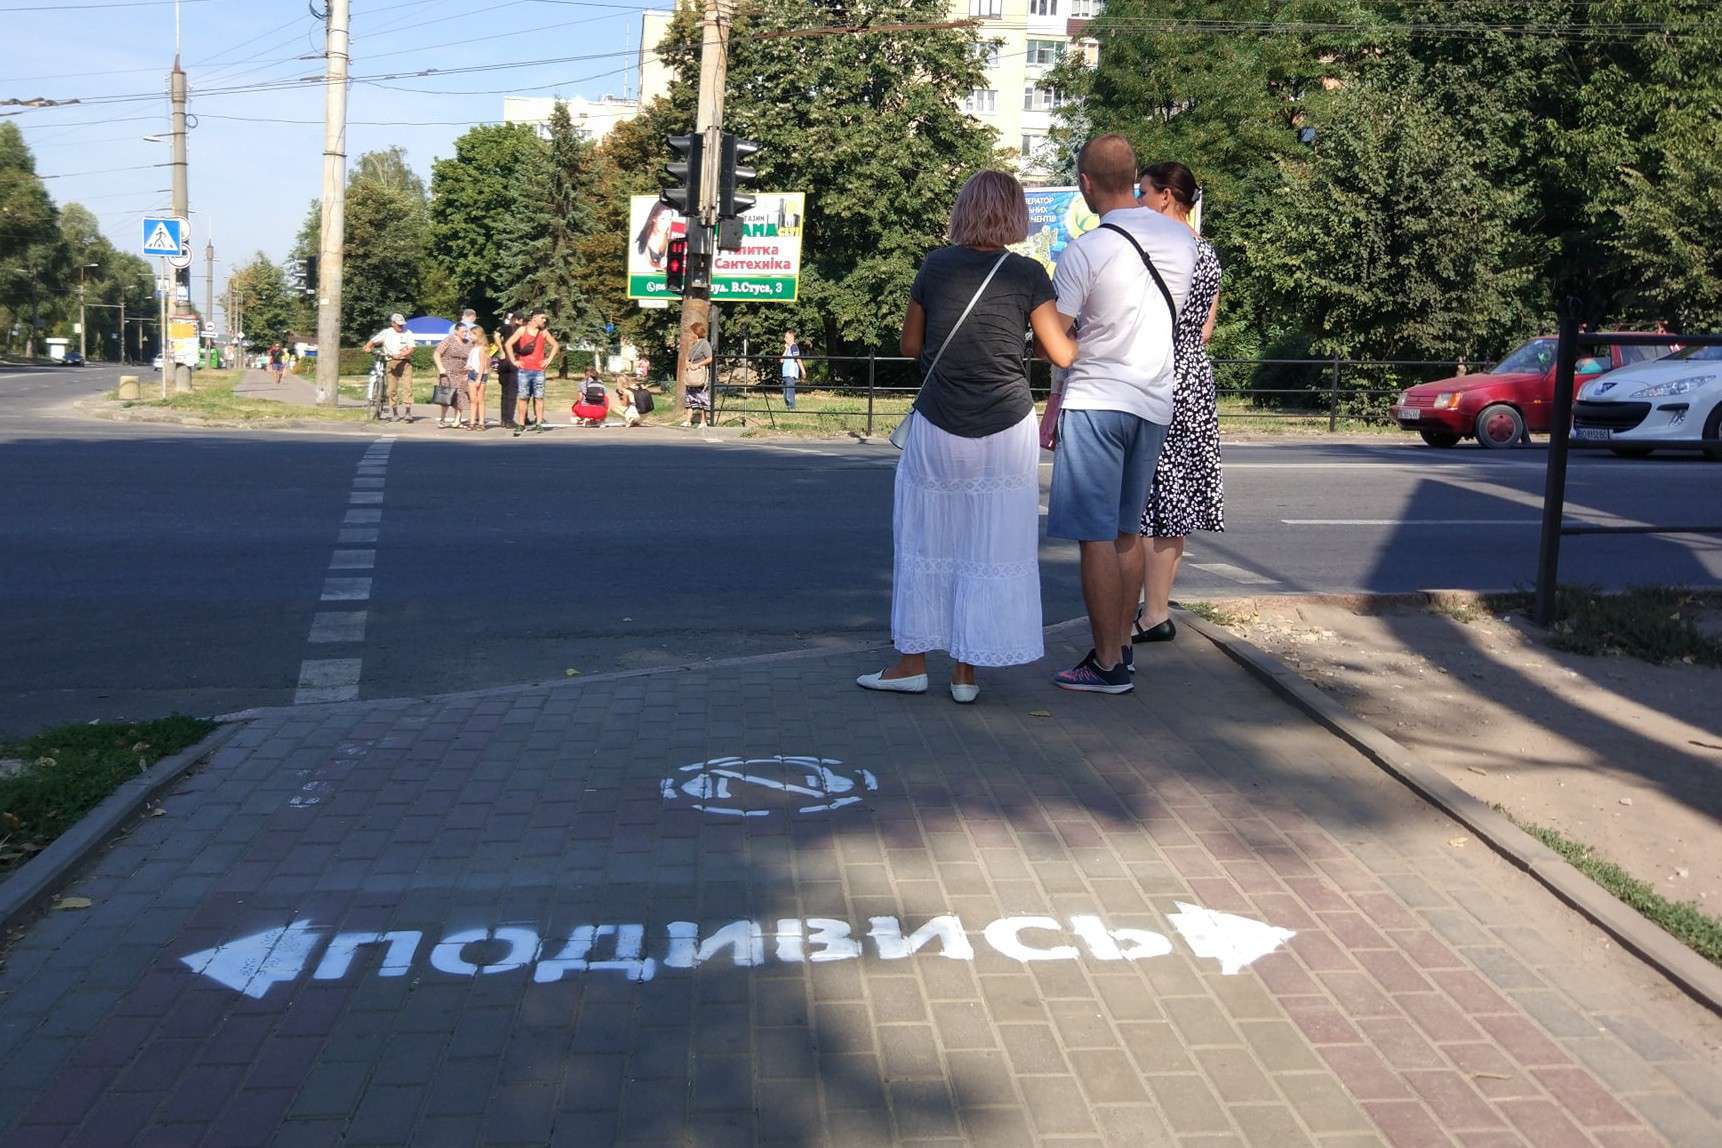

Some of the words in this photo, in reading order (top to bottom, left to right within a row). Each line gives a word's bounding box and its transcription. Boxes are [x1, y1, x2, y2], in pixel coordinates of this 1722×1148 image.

[1024, 197, 1055, 205] ПЕРАТОР
[714, 257, 792, 270] Сантехніка
[775, 281, 783, 293] 3
